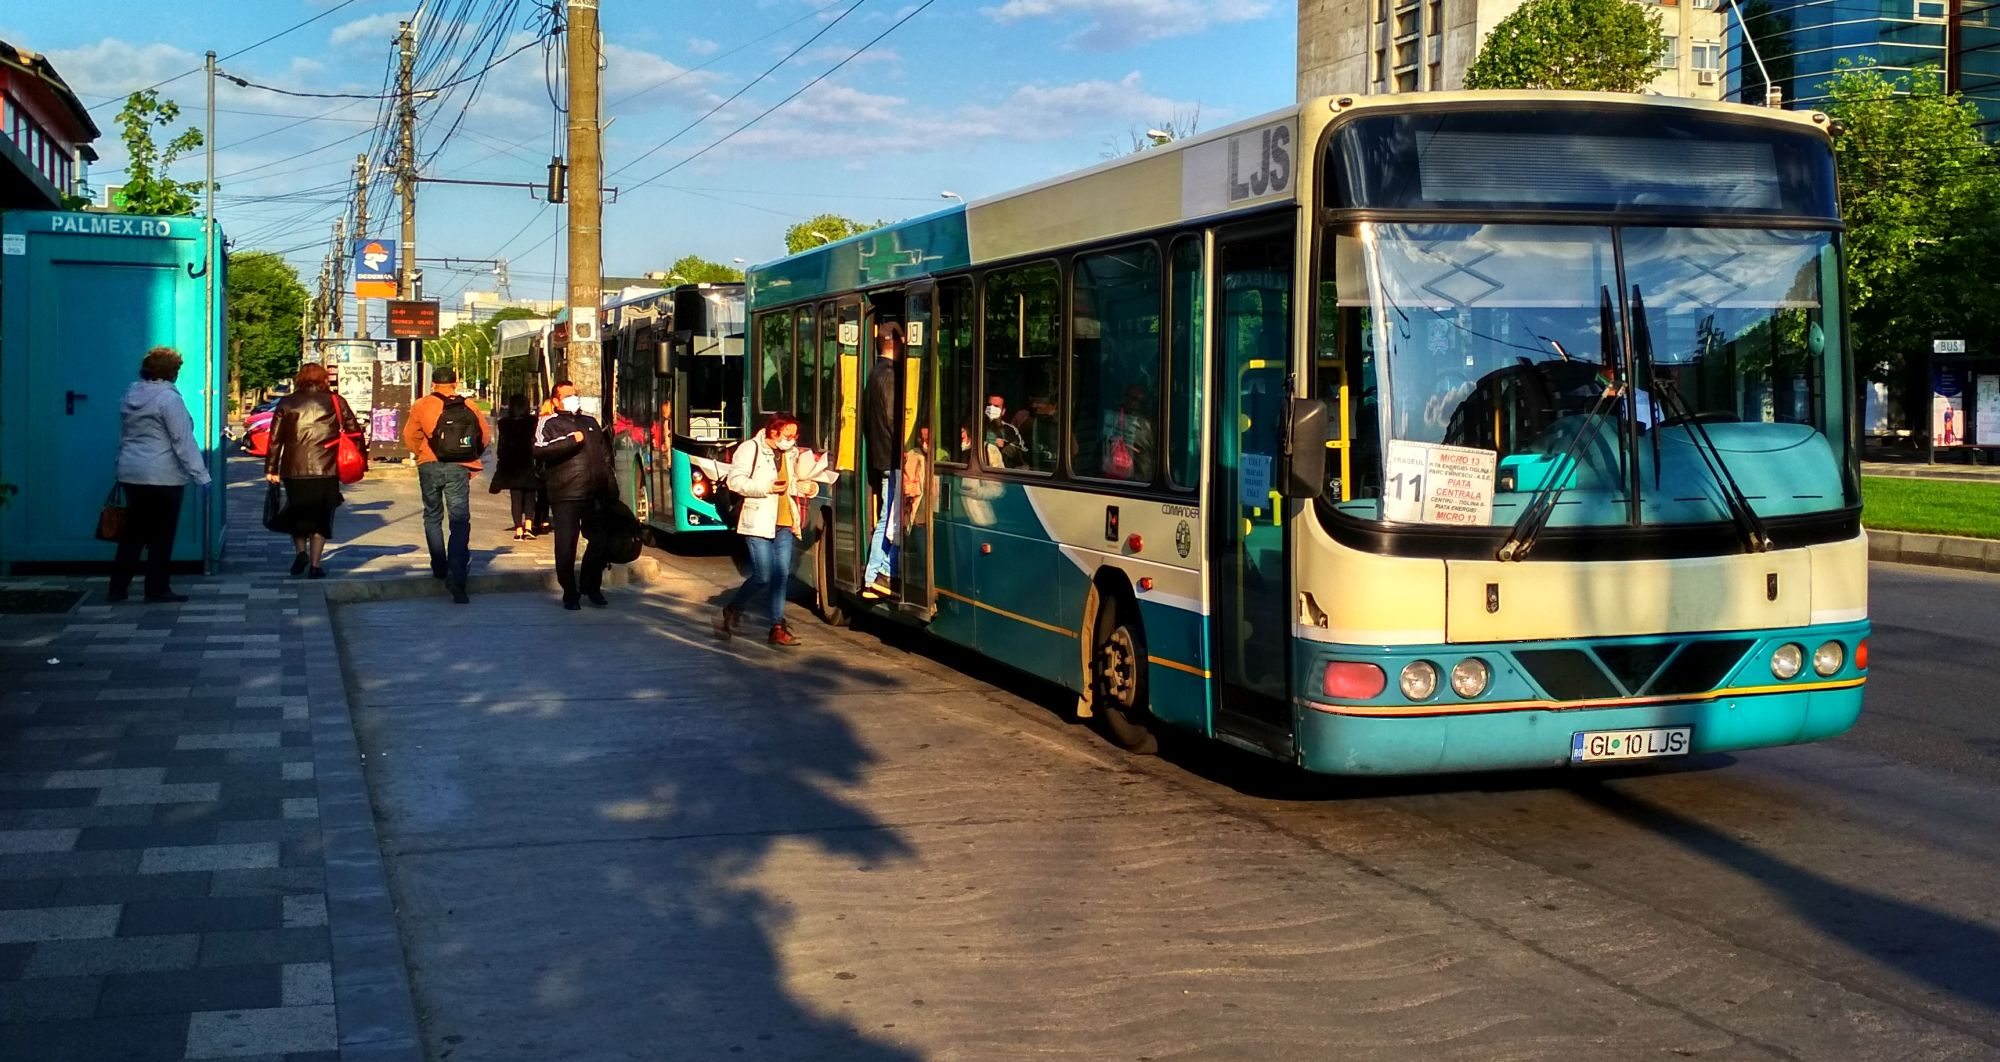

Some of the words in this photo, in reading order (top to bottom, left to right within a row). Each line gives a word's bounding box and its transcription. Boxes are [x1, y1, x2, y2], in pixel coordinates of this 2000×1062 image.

[1231, 125, 1290, 201] LJS
[51, 215, 171, 237] PALMEX.RO
[1940, 341, 1959, 352] BUS
[1440, 453, 1469, 464] MICRO
[1471, 456, 1480, 465] 13
[1389, 472, 1422, 502] 11
[1447, 478, 1471, 488] PIATA
[1436, 487, 1482, 500] CENTRALA
[1162, 504, 1200, 519] COMMANDER
[1436, 511, 1465, 522] MICRO
[1574, 748, 1583, 758] RO
[1590, 735, 1615, 756] GL
[1625, 734, 1643, 755] 10
[1648, 732, 1684, 753] LJS
